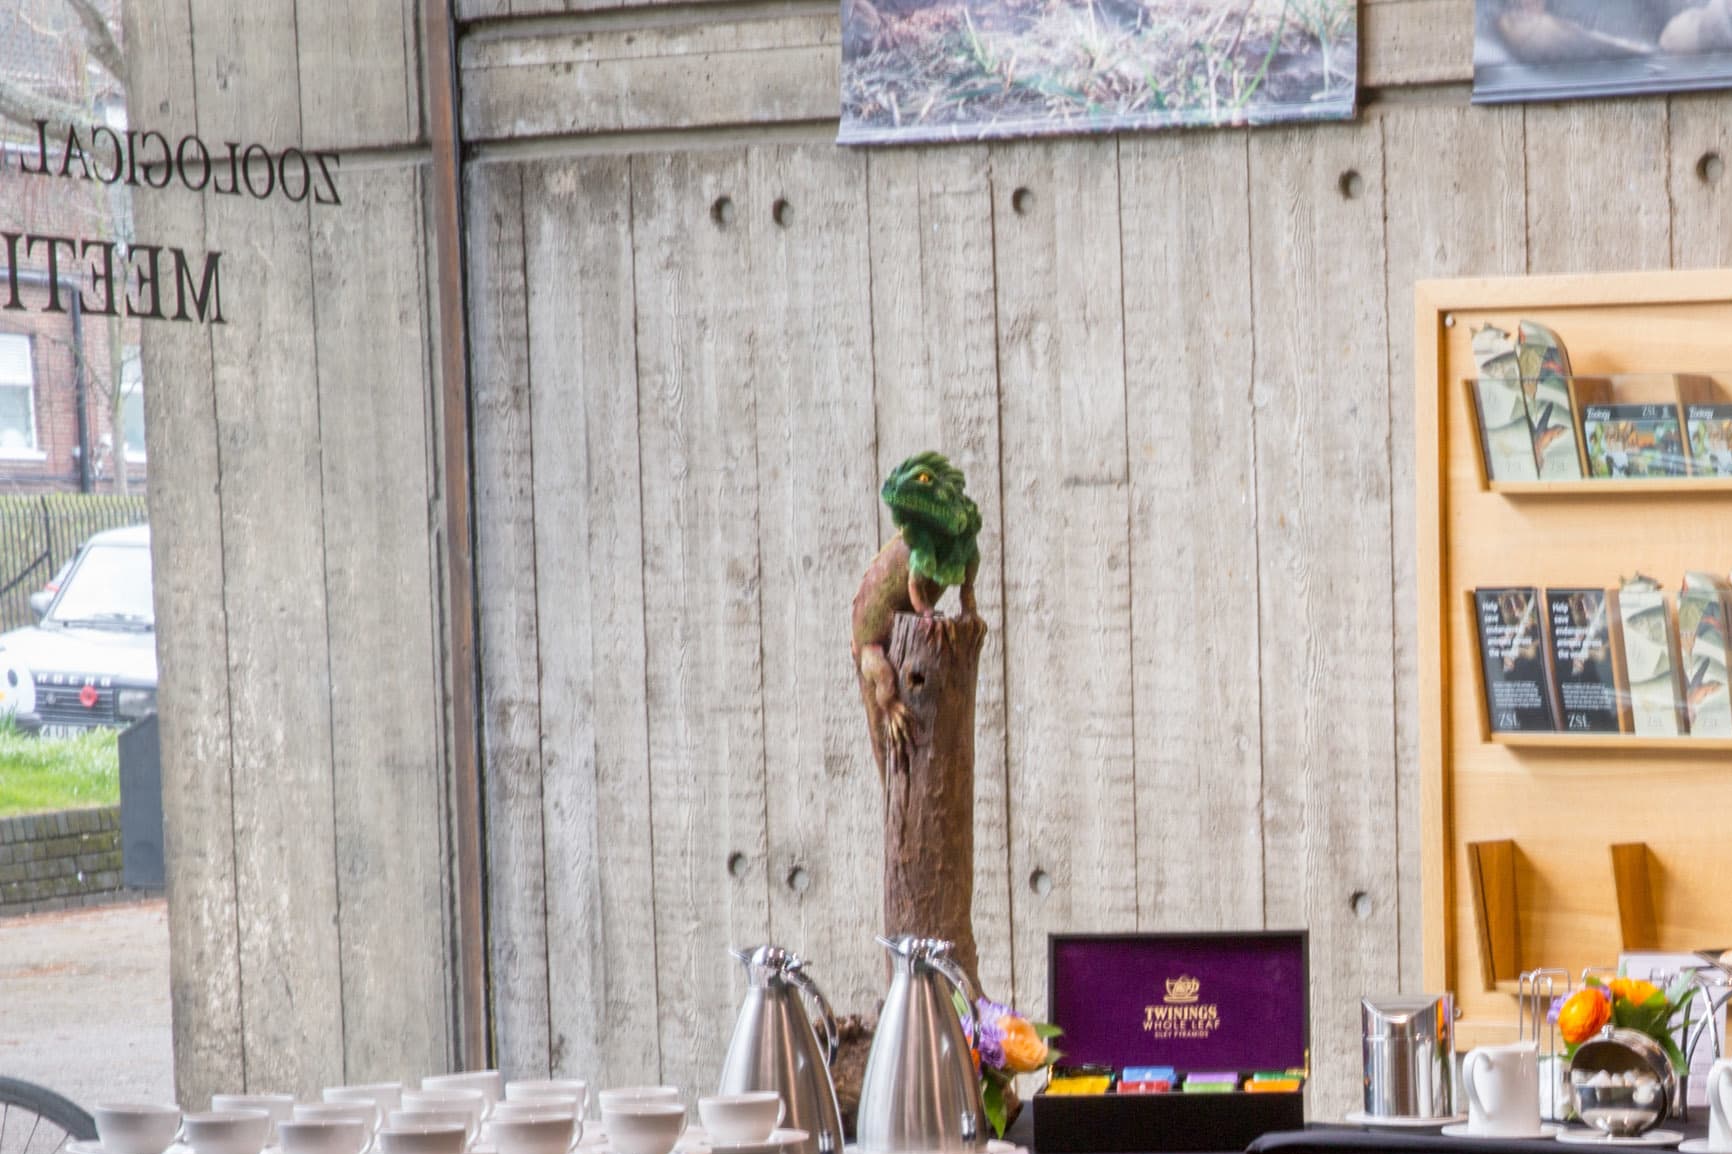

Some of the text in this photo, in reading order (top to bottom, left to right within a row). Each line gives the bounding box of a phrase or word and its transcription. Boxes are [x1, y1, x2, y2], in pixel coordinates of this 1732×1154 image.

[1499, 711, 1520, 728] ZSL
[1568, 713, 1589, 729] ZSL
[1144, 1005, 1218, 1020] TWININGS
[1143, 1018, 1221, 1031] WHOLE LEAF
